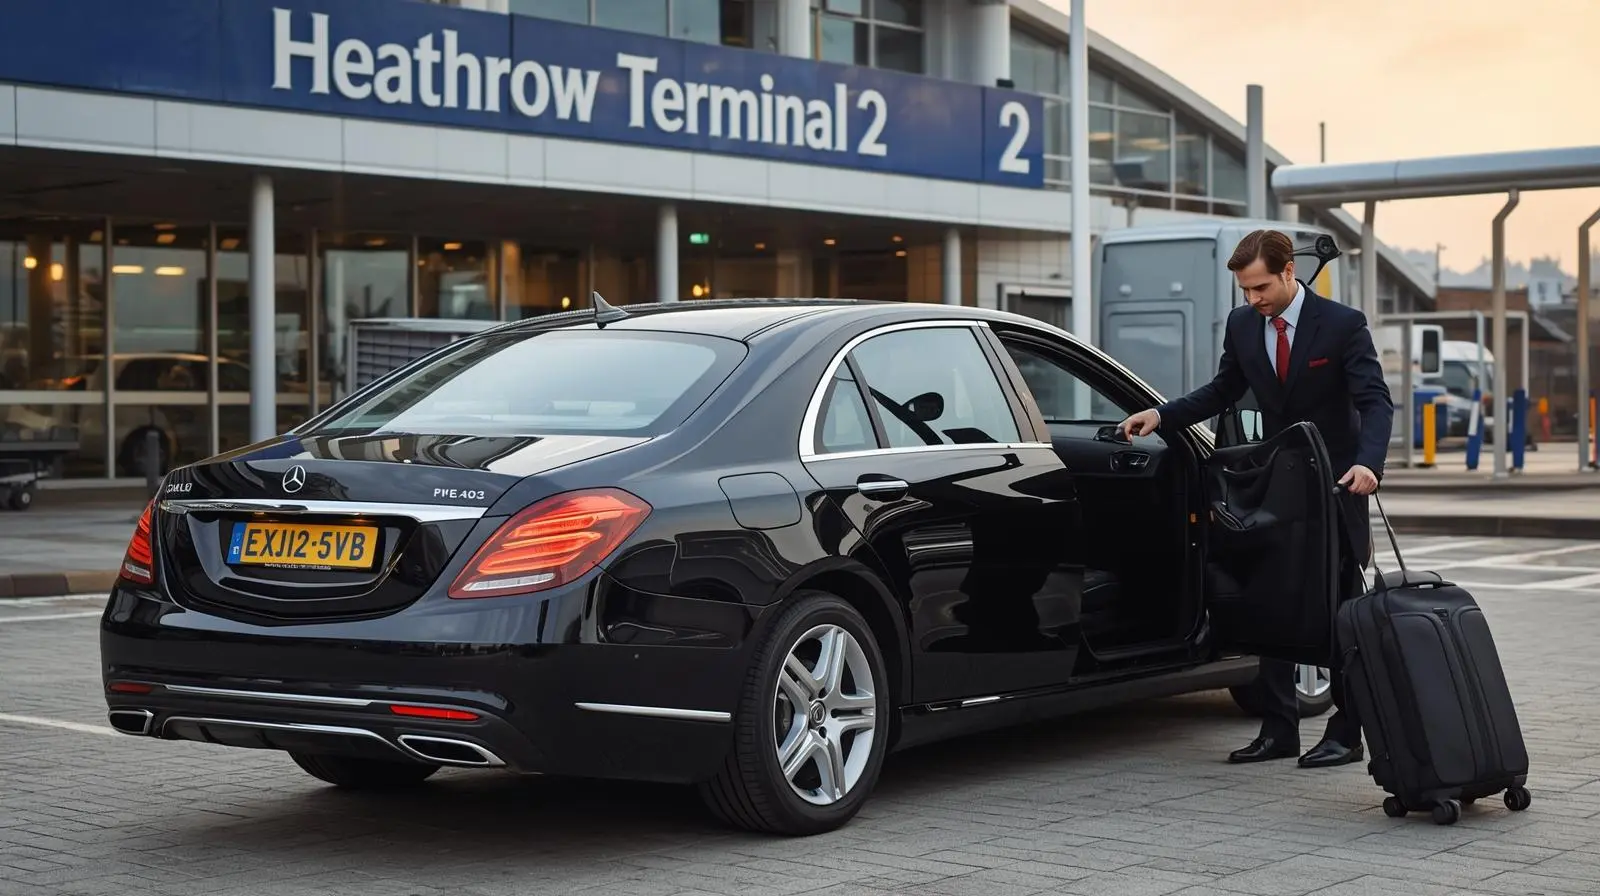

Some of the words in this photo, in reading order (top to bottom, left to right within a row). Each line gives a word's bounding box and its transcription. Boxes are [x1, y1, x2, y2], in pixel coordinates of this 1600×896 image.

[272, 7, 600, 123] Heathrow
[617, 52, 848, 152] Terminal
[857, 89, 888, 156] 2
[999, 101, 1031, 174] 2
